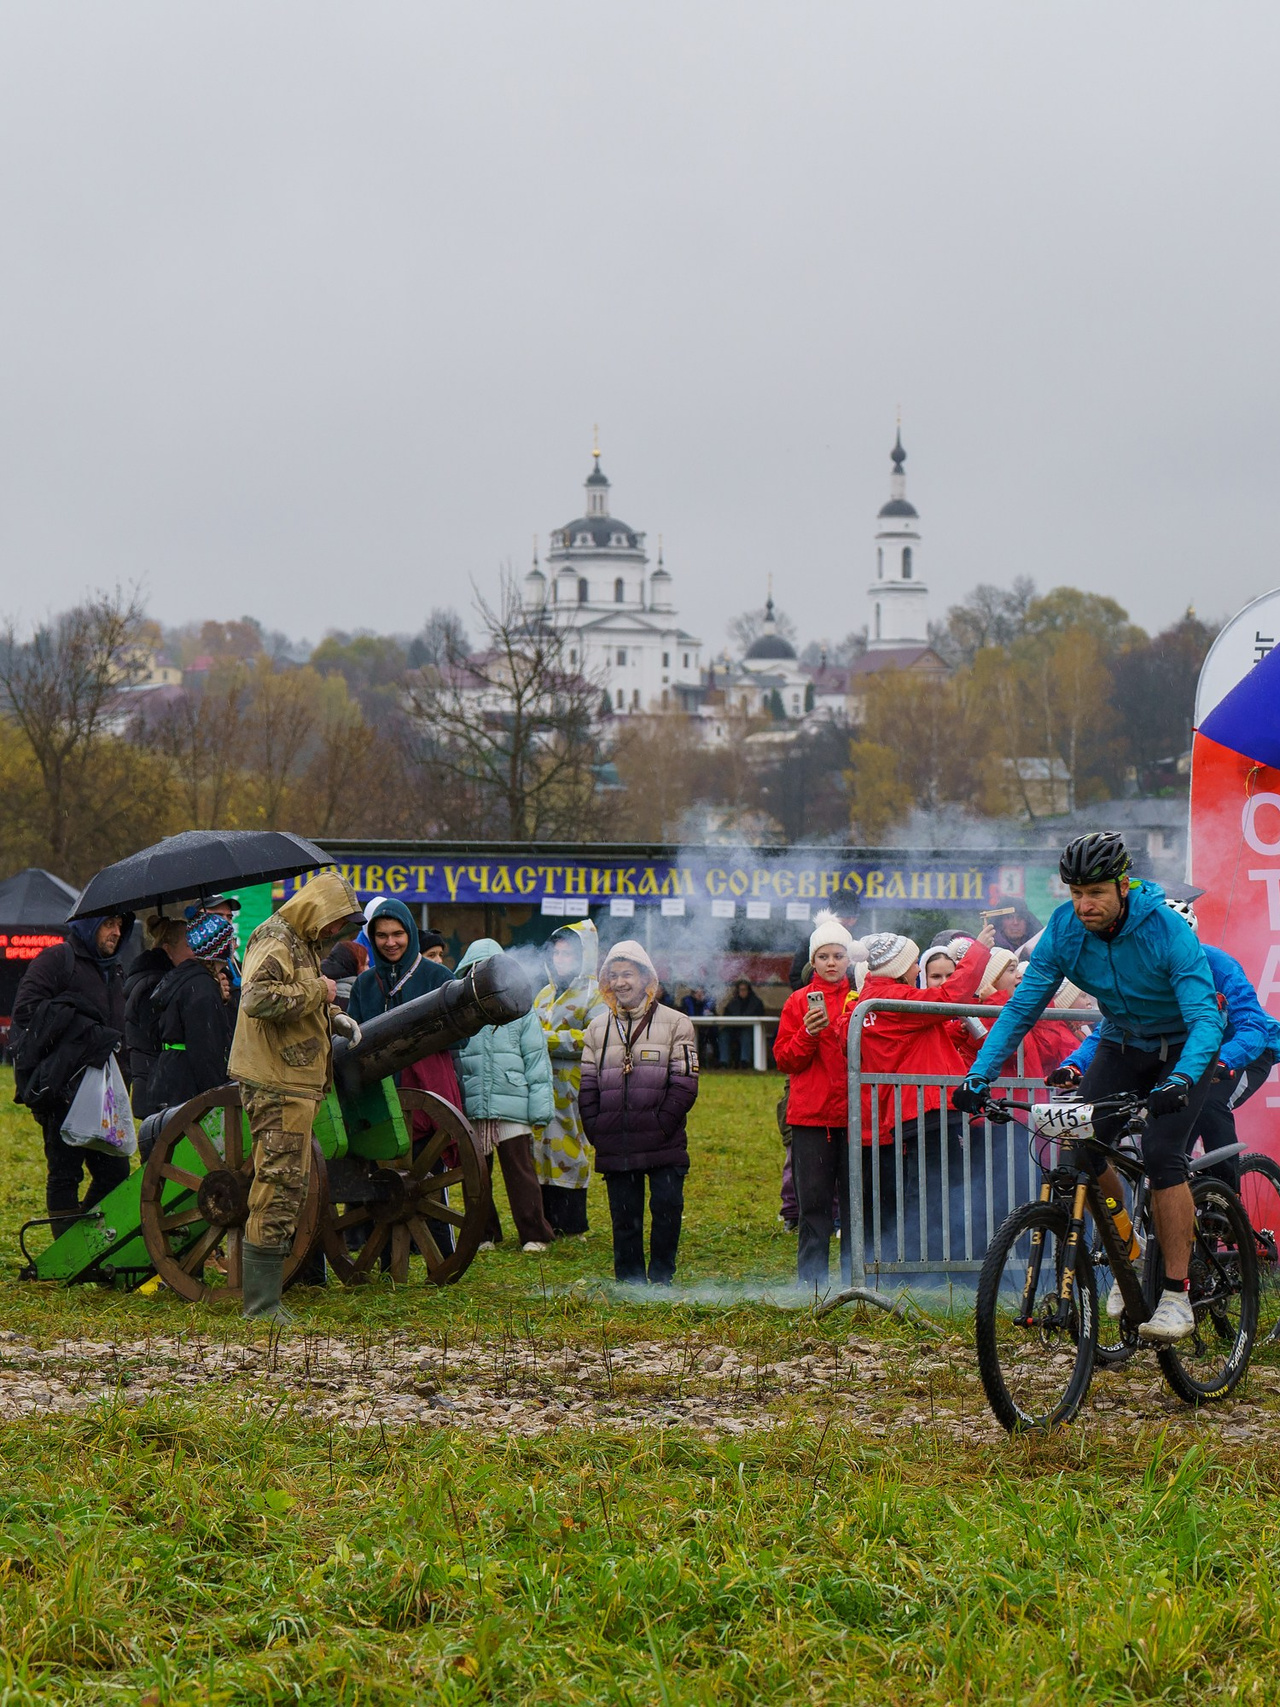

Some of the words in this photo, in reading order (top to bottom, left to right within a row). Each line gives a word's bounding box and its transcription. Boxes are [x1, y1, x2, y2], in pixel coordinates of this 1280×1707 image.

[444, 863, 696, 903] УЧАСТНИКАМ
[705, 867, 985, 900] СОРЕВНОВАНИЙ
[1044, 1108, 1079, 1127] 115
[1061, 1266, 1076, 1301] FOX
